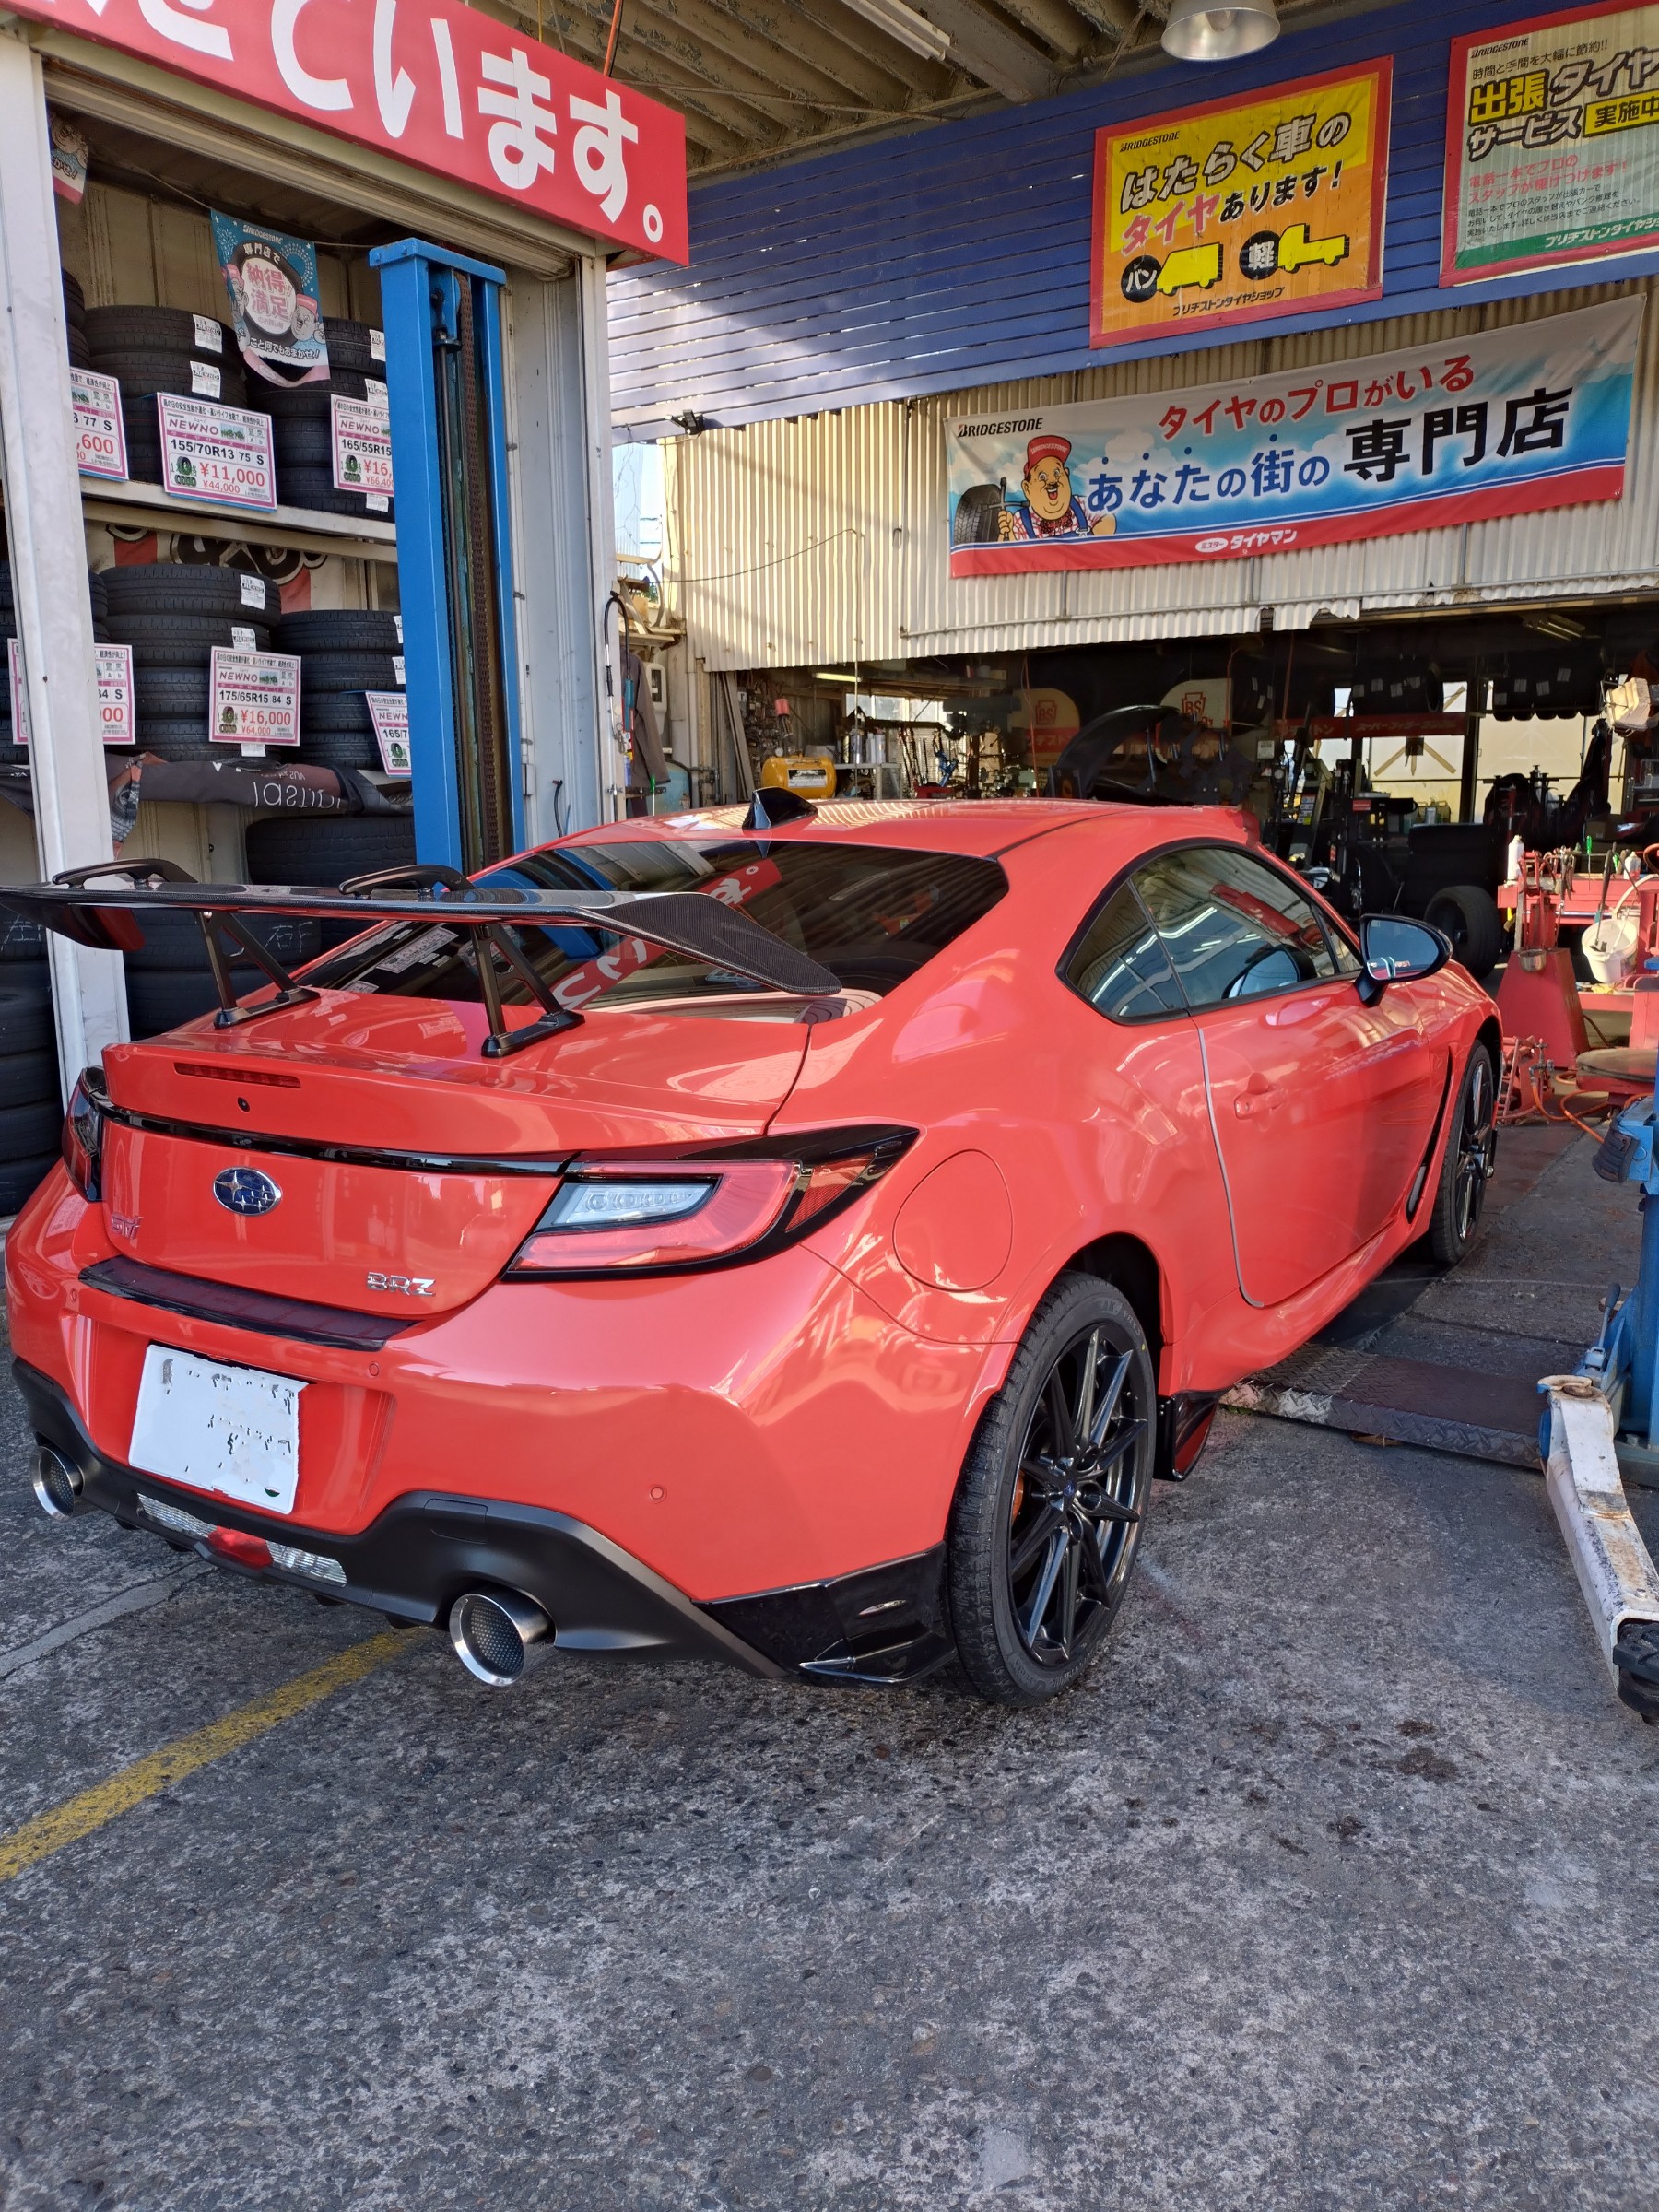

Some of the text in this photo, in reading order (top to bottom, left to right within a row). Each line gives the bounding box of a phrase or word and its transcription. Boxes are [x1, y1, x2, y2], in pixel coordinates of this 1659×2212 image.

[1471, 38, 1529, 59] BRIDGESTONE
[1594, 95, 1659, 128] 実施中
[1120, 131, 1180, 152] BRIDGESTONE
[1468, 105, 1583, 162] サービス
[1120, 112, 1352, 214] はたらく車の
[1468, 154, 1578, 188] 電話一本でプロの
[243, 242, 280, 265] 専門店で
[1248, 241, 1274, 269] 軽
[1126, 268, 1157, 292] バン
[251, 288, 290, 320] 満足
[1159, 354, 1476, 441] タイヤのプロがいる
[84, 416, 96, 427] 77
[104, 419, 112, 431] S
[170, 418, 218, 436] NEWNO
[340, 420, 379, 434] NEWNO
[958, 418, 1043, 438] BRIDGESTONE
[76, 434, 113, 454] ,600
[171, 439, 264, 465] 155/70R13 75 S
[342, 439, 392, 456] 165/55R15
[199, 462, 265, 487] ¥11,000
[364, 459, 392, 478] ¥16,
[366, 476, 394, 487] ¥66,40
[1230, 530, 1297, 549] タイヤマン
[219, 671, 257, 682] NEWNO
[115, 689, 123, 700] S
[219, 690, 269, 703] 175/65R15
[286, 696, 292, 705] S
[241, 709, 291, 726] ¥16,000
[379, 712, 408, 721] NEWN
[383, 728, 407, 738] 165/7
[367, 1271, 436, 1297] BRZ
